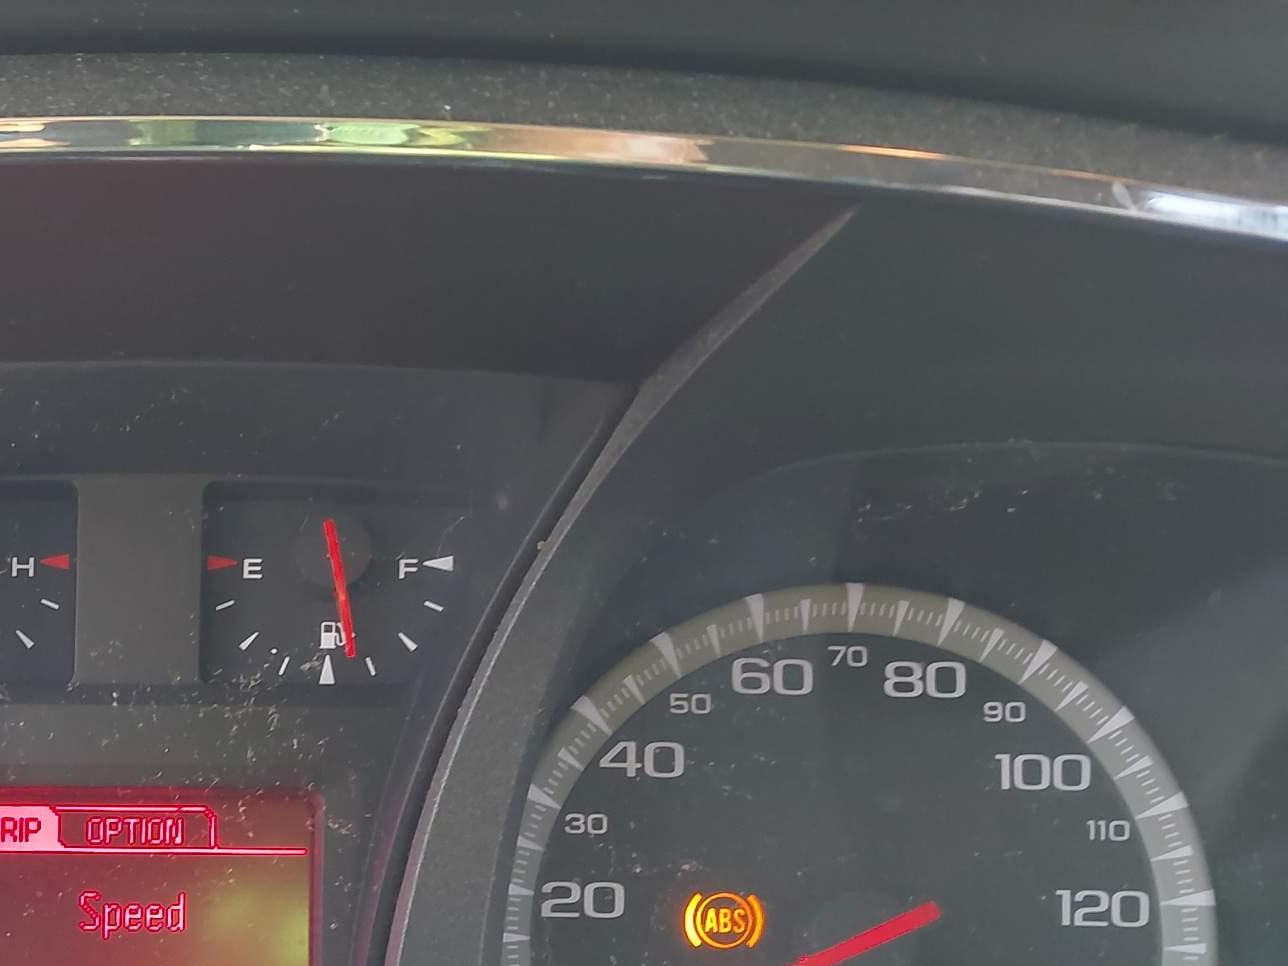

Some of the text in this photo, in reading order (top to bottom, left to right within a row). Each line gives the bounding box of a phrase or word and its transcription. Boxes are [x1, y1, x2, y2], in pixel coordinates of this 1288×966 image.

[11, 557, 35, 578] H
[242, 558, 263, 579] E
[398, 558, 418, 579] F
[828, 646, 868, 667] 70
[731, 658, 813, 696] 60
[883, 661, 966, 699] 80
[669, 694, 711, 715] 50
[983, 702, 1026, 724] 90
[599, 741, 685, 778] 40
[994, 753, 1091, 792] 100
[86, 817, 185, 845] OPTION
[564, 813, 608, 835] 30
[1087, 820, 1130, 842] 110
[540, 881, 626, 918] 20
[1056, 889, 1150, 928] 120
[78, 890, 187, 940] Speed
[704, 907, 746, 934] ABS
